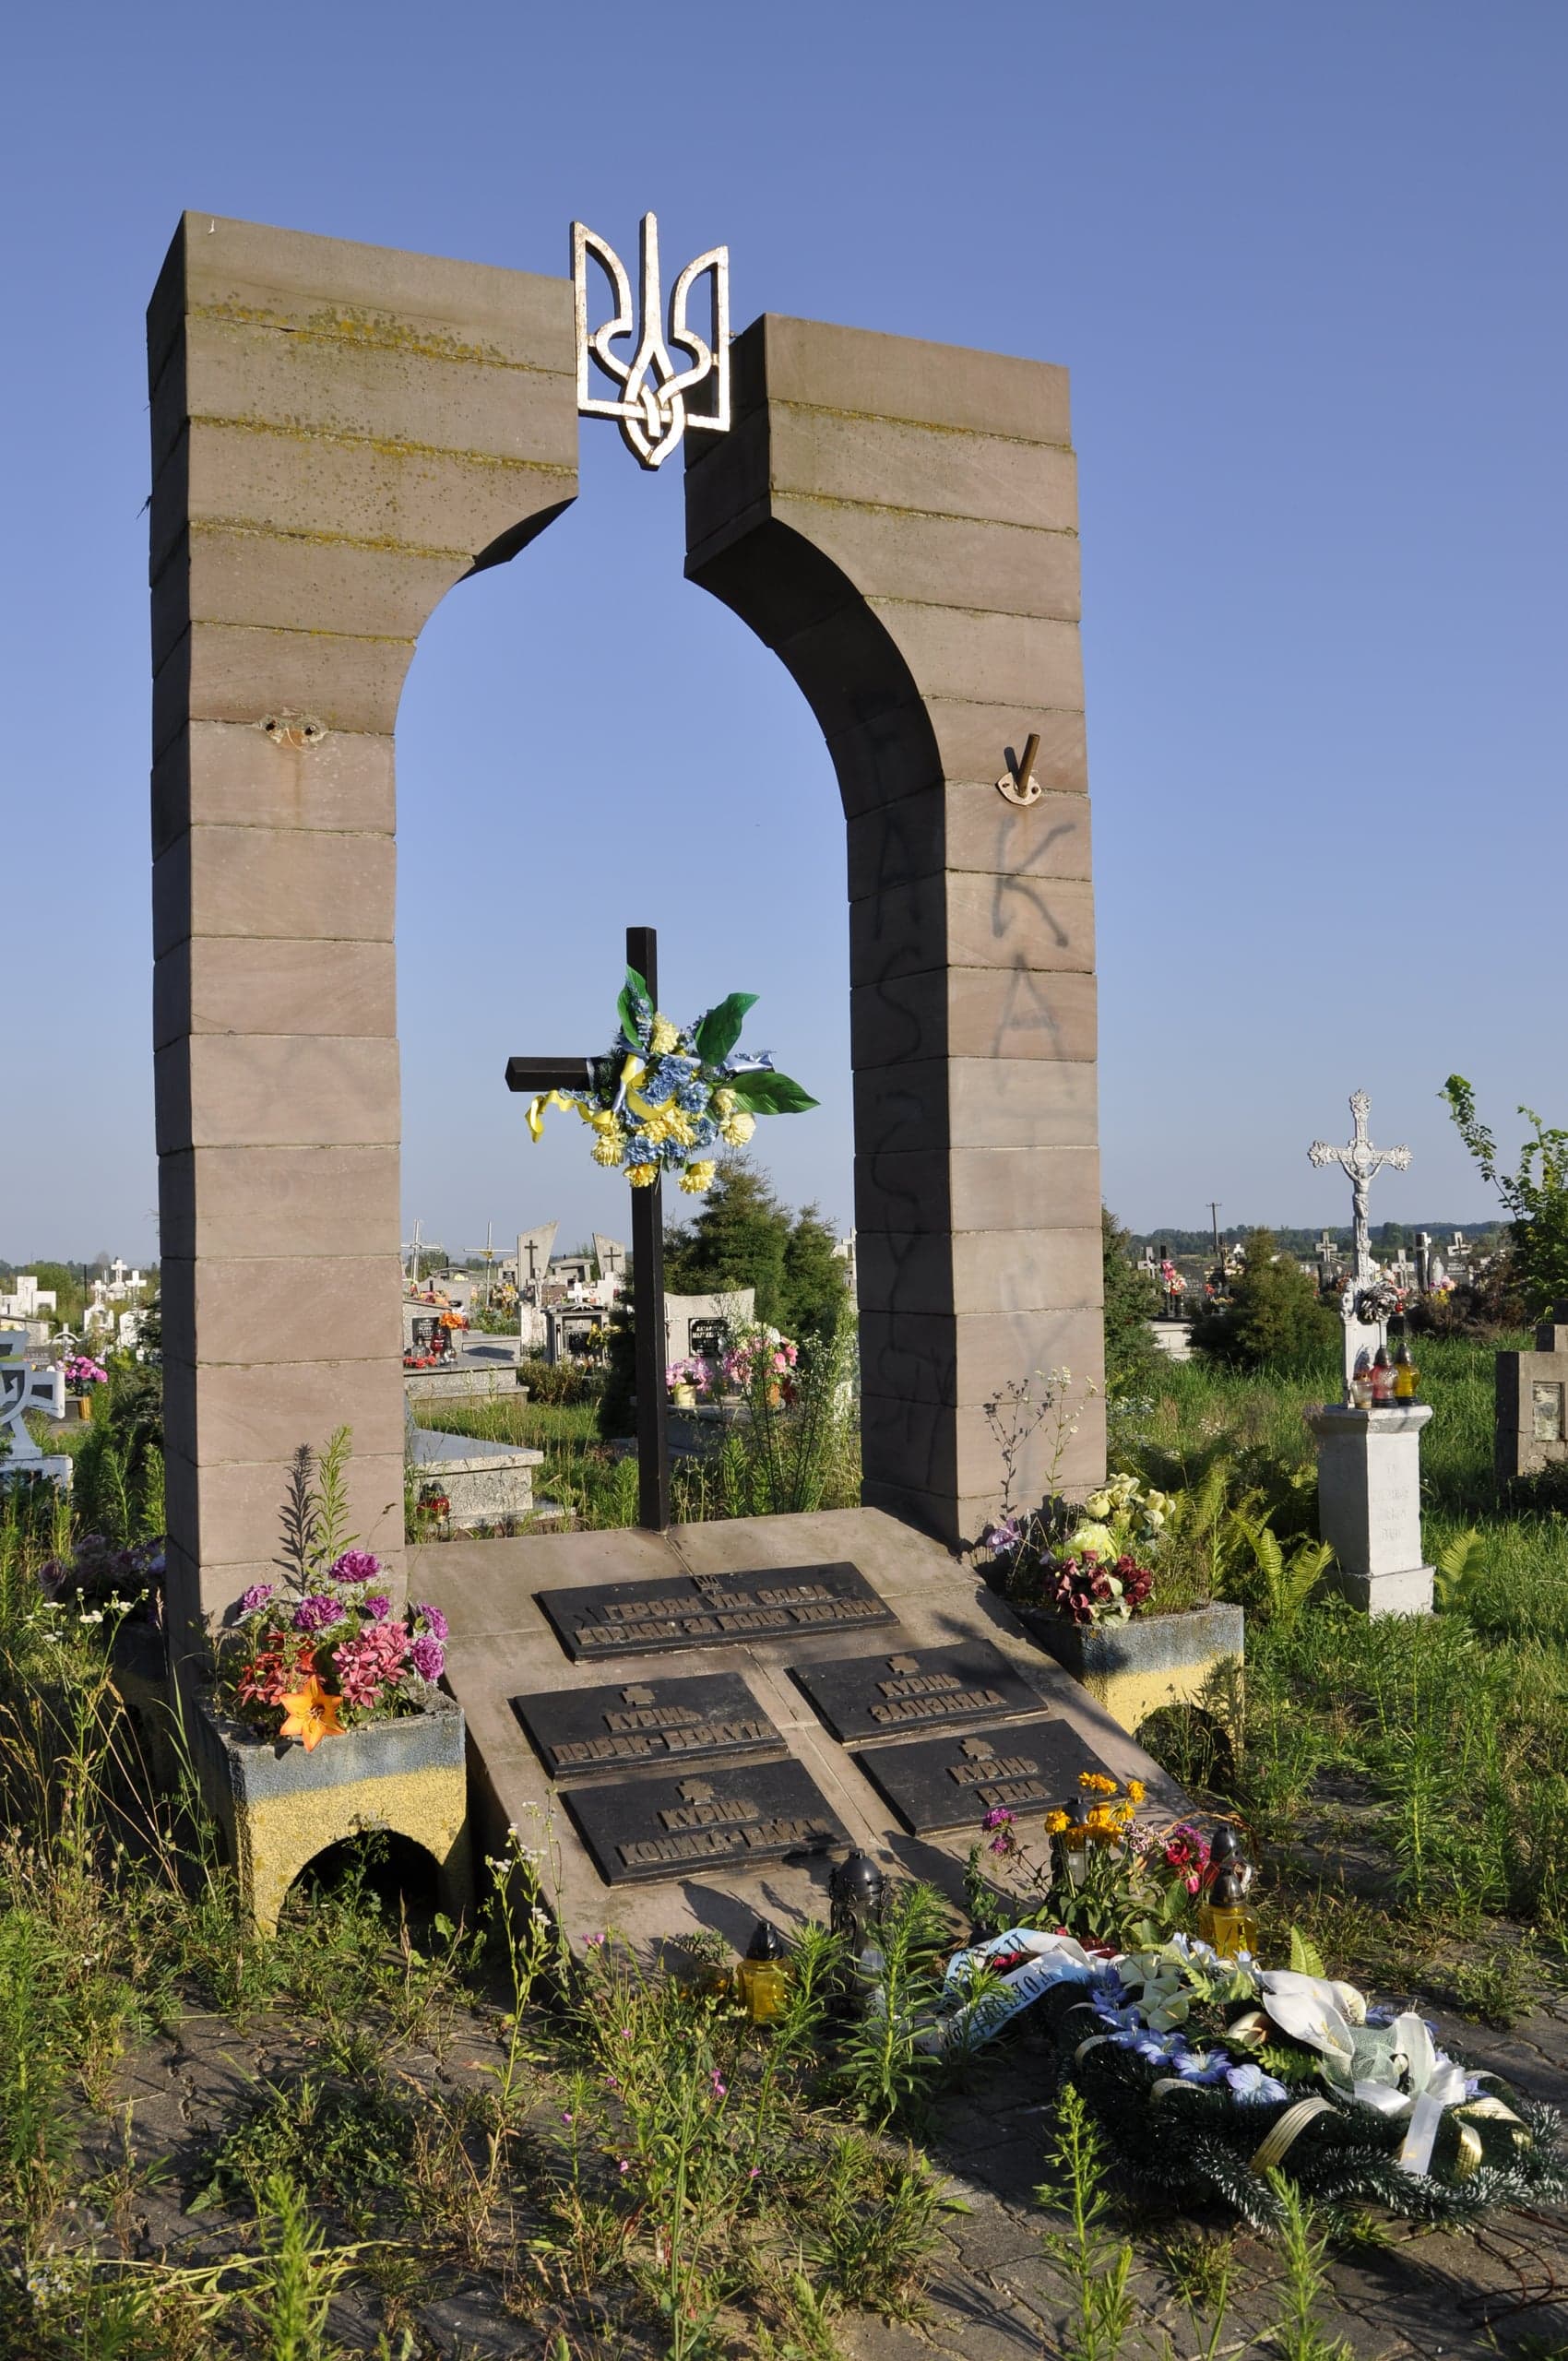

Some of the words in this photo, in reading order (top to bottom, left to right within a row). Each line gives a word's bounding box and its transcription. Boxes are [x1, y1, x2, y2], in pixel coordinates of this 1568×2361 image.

[603, 1597, 703, 1620] ГЕРОЯМ
[707, 1593, 757, 1609] УПА
[757, 1584, 835, 1605] СЛАВА
[575, 1620, 683, 1646] БОРЦЯМ
[684, 1617, 717, 1633] ЗА
[719, 1610, 790, 1631] ВОЛЮ
[790, 1598, 887, 1623] УКРАЇНИ
[876, 1673, 962, 1699] КУРІНЬ
[604, 1707, 704, 1732] КУРІНЬ
[870, 1689, 1007, 1723] ЗАЛІЗНЯКА
[946, 1756, 1039, 1786] КУРІНЬ
[977, 1780, 1052, 1808] РЕНА
[659, 1800, 760, 1832] КУРІНЬ
